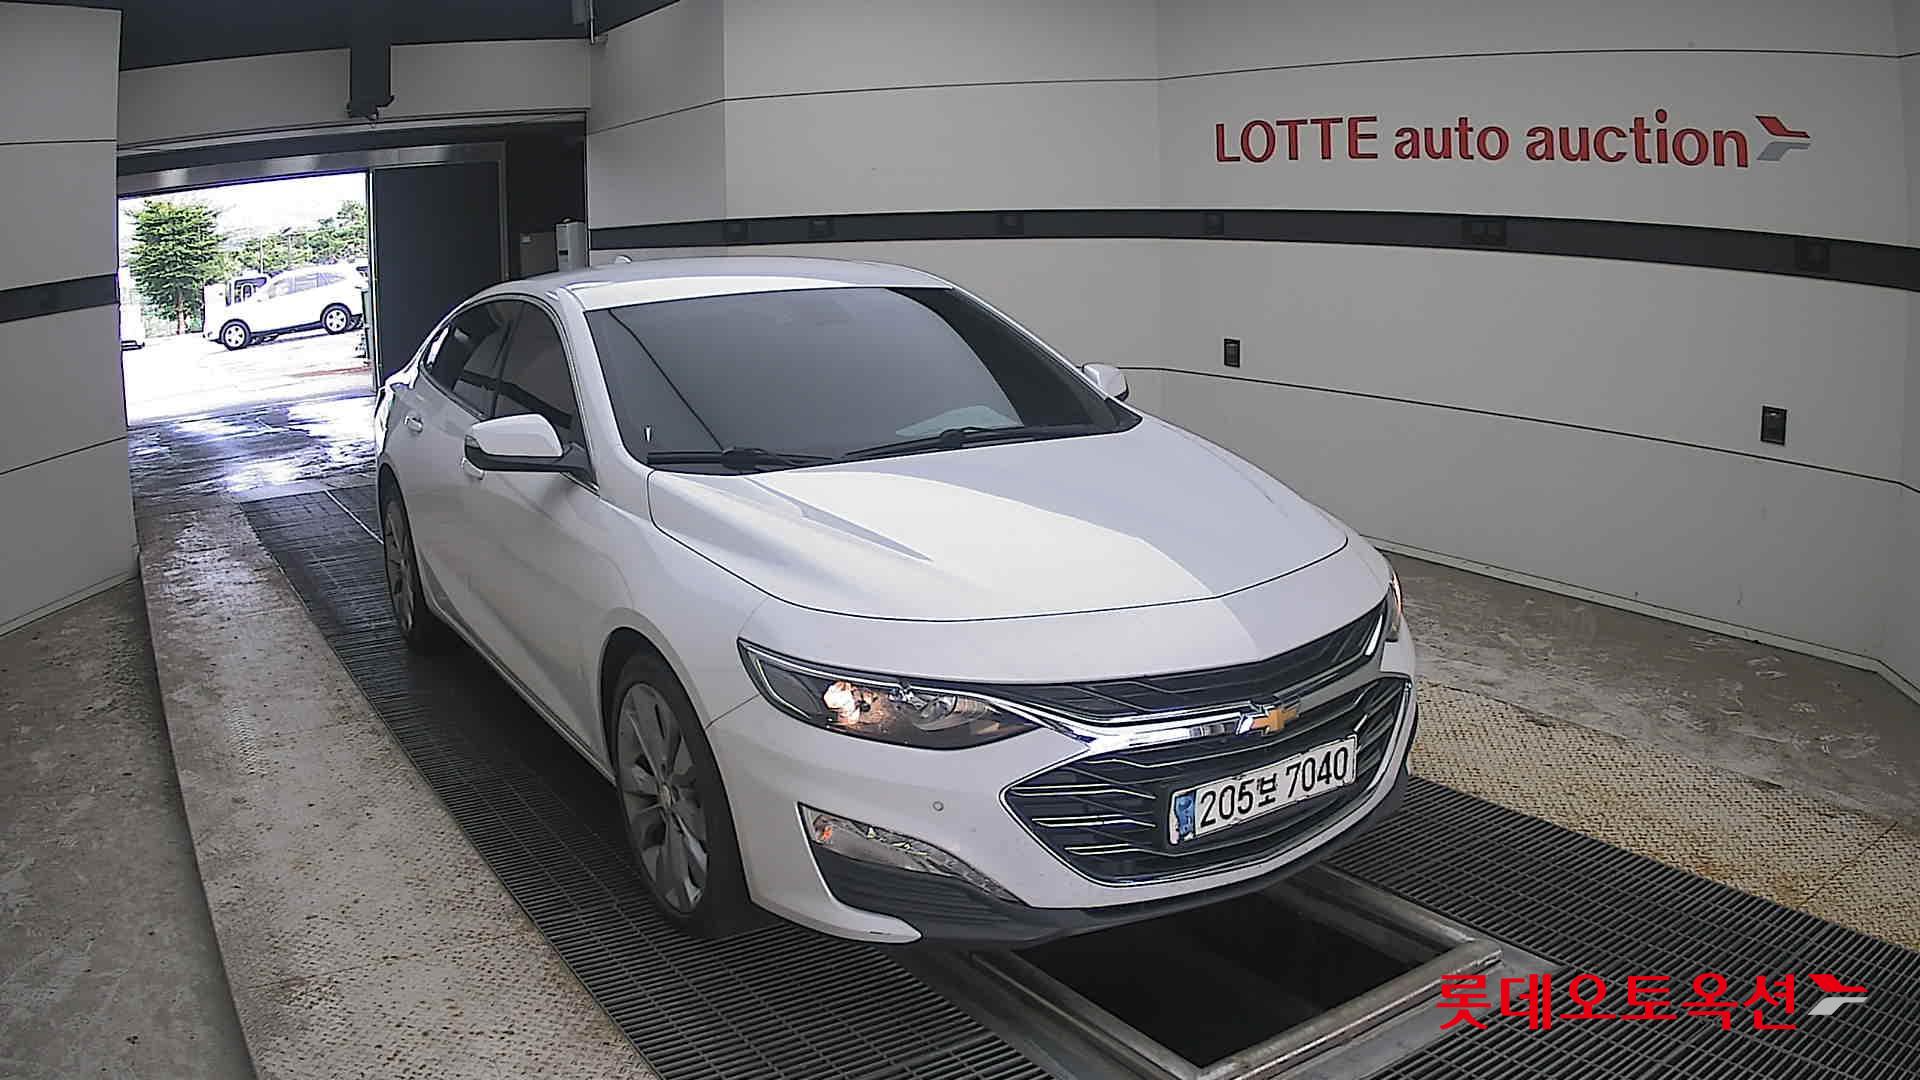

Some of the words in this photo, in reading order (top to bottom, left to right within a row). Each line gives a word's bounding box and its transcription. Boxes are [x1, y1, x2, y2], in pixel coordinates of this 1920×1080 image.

[1215, 116, 1378, 162] LOTTE
[1394, 117, 1509, 161] auto
[1526, 109, 1749, 167] auction
[1286, 747, 1348, 798] 7040
